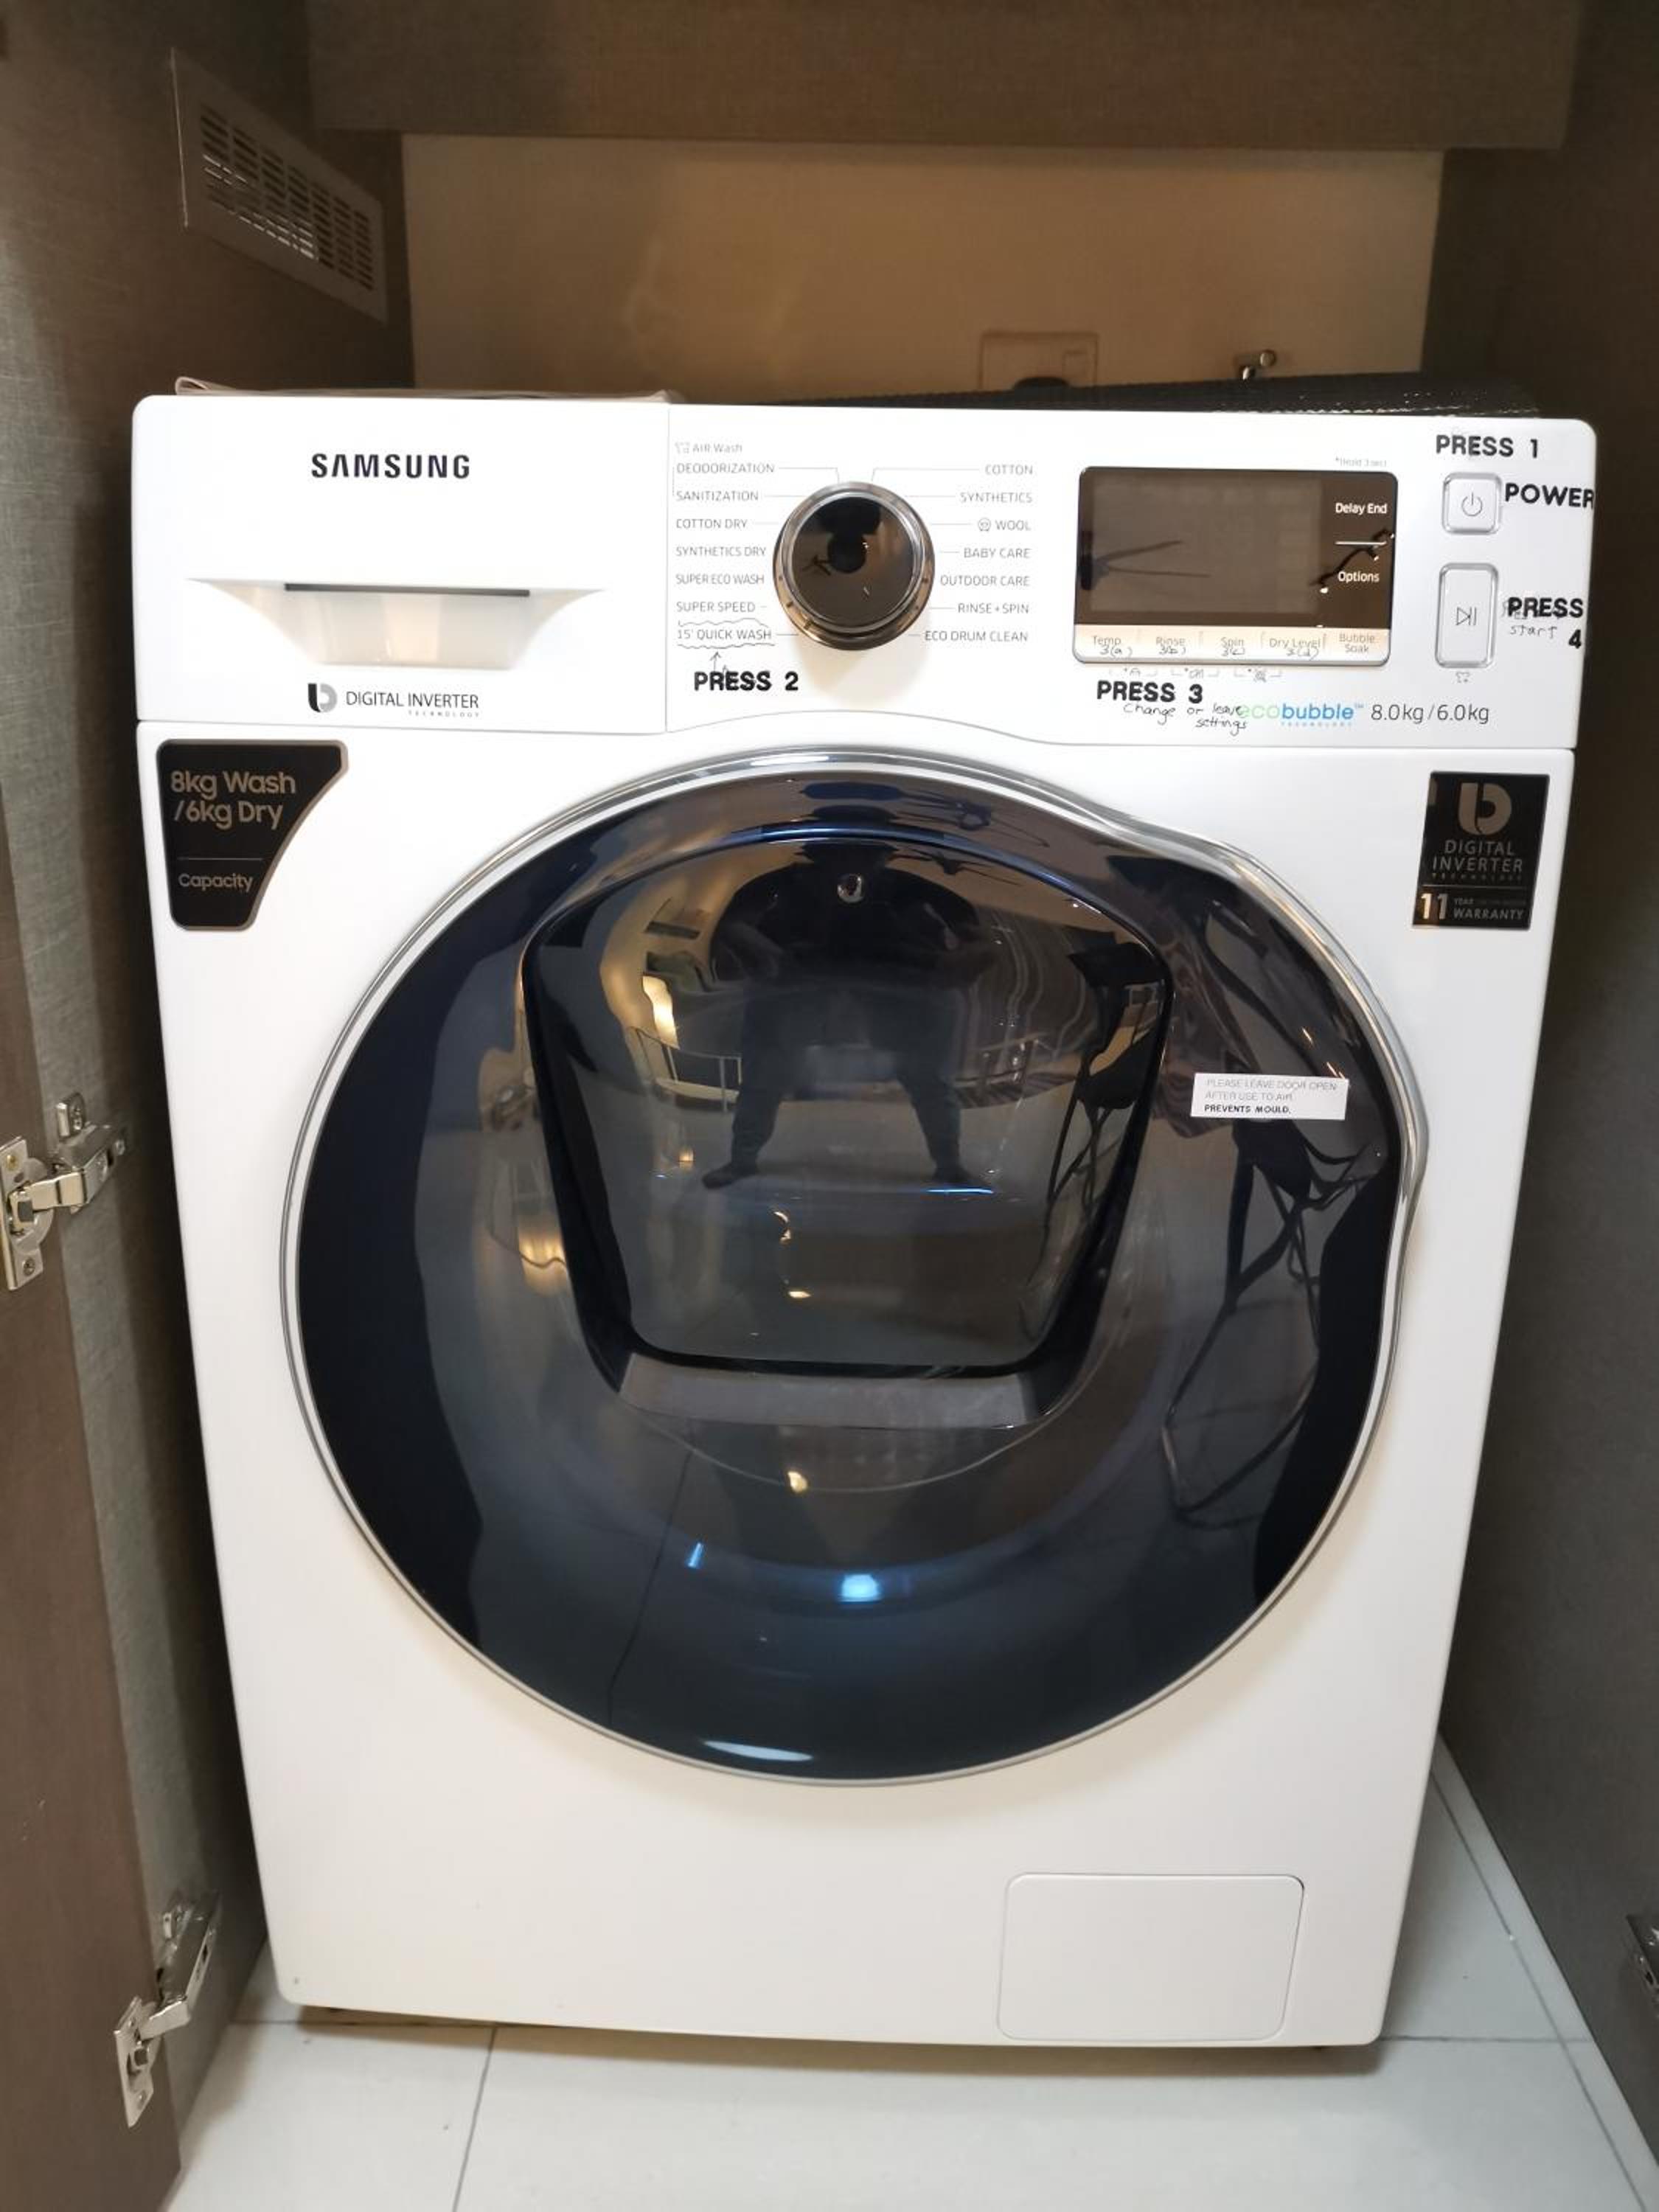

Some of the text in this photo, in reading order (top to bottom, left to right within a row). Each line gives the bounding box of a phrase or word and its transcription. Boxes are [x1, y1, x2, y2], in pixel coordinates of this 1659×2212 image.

[714, 443, 742, 453] Wash
[1436, 434, 1538, 459] PRESS 1
[311, 453, 470, 479] SAMSUNG
[676, 462, 775, 474] DEODORIZATION
[985, 464, 1033, 475] COTTON
[676, 490, 759, 501] SANITIZATION
[960, 493, 1033, 503] SYNTHETICS
[1505, 483, 1594, 509] POWER
[1335, 502, 1388, 515] Delay End
[676, 518, 748, 529] COTTON DRY
[995, 520, 1032, 531] WOOL
[676, 546, 766, 557] SYNTHETICS DRY
[964, 548, 1031, 558] BABY CARE
[675, 574, 765, 585] SUPER ECO WASH
[940, 575, 1031, 586] OUTDOOR CARE
[1338, 571, 1380, 583] Options
[676, 602, 756, 612] SUPER SPEED
[1508, 597, 1583, 618] PRESS
[678, 629, 771, 641] 15' QUICK WASH
[925, 631, 1029, 641] ECO DRUM CLEAN
[1155, 636, 1186, 646] Rinse
[1339, 633, 1375, 644] Bubble
[1568, 629, 1582, 649] 4
[1092, 636, 1121, 647] Temp
[1220, 637, 1245, 649] Spin
[1269, 638, 1321, 649] Dry Level
[1345, 644, 1369, 653] Soak
[694, 671, 799, 691] PRESS 2
[1096, 679, 1203, 703] PRESS 3
[346, 691, 479, 709] DIGITAL INVERTER
[1124, 702, 1176, 725] Change
[1186, 706, 1204, 715] or
[1194, 717, 1248, 737] settings
[170, 771, 296, 800] 8kg Wash
[174, 799, 283, 830] /6kg Dry
[1444, 839, 1514, 856] DIGITAL
[1433, 855, 1523, 872] INVERTER
[178, 872, 254, 892] Capacity
[1421, 893, 1449, 919] 11
[1453, 907, 1524, 920] WARRANTY
[1206, 1079, 1338, 1091] PLEASE LEAVE DOOR OPEN
[1204, 1091, 1237, 1100] AFTER
[1238, 1091, 1259, 1101] USE
[1262, 1092, 1274, 1101] TO
[1204, 1104, 1292, 1115] PREVENTS MOULD.
